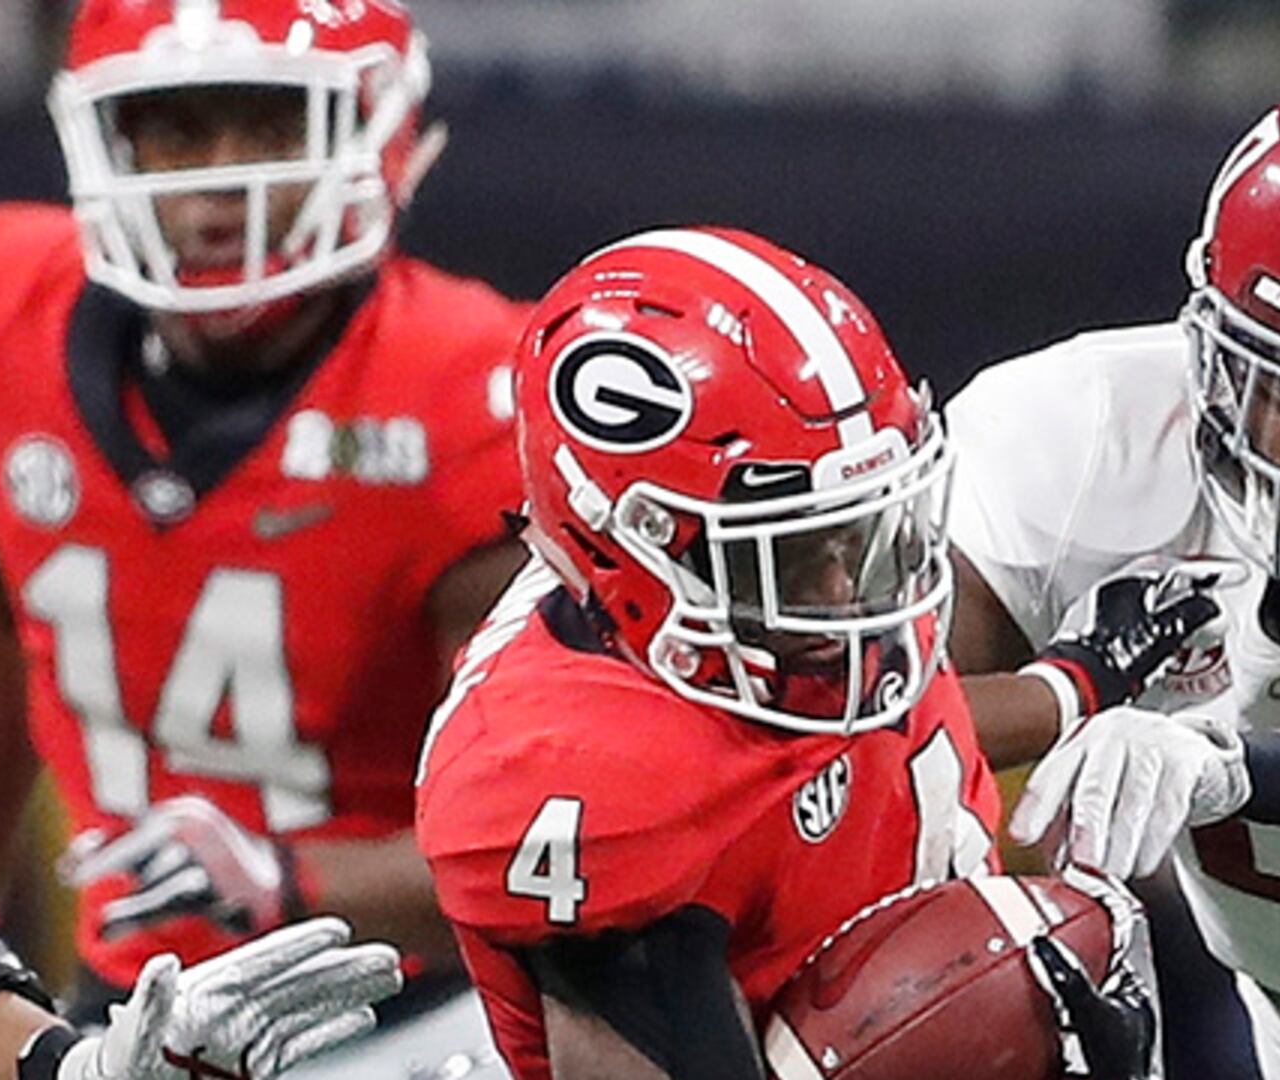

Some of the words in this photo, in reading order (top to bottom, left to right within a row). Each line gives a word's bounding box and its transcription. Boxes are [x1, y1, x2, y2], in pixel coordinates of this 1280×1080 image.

[554, 338, 685, 445] G
[25, 542, 333, 833] 14
[507, 797, 586, 923] 4
